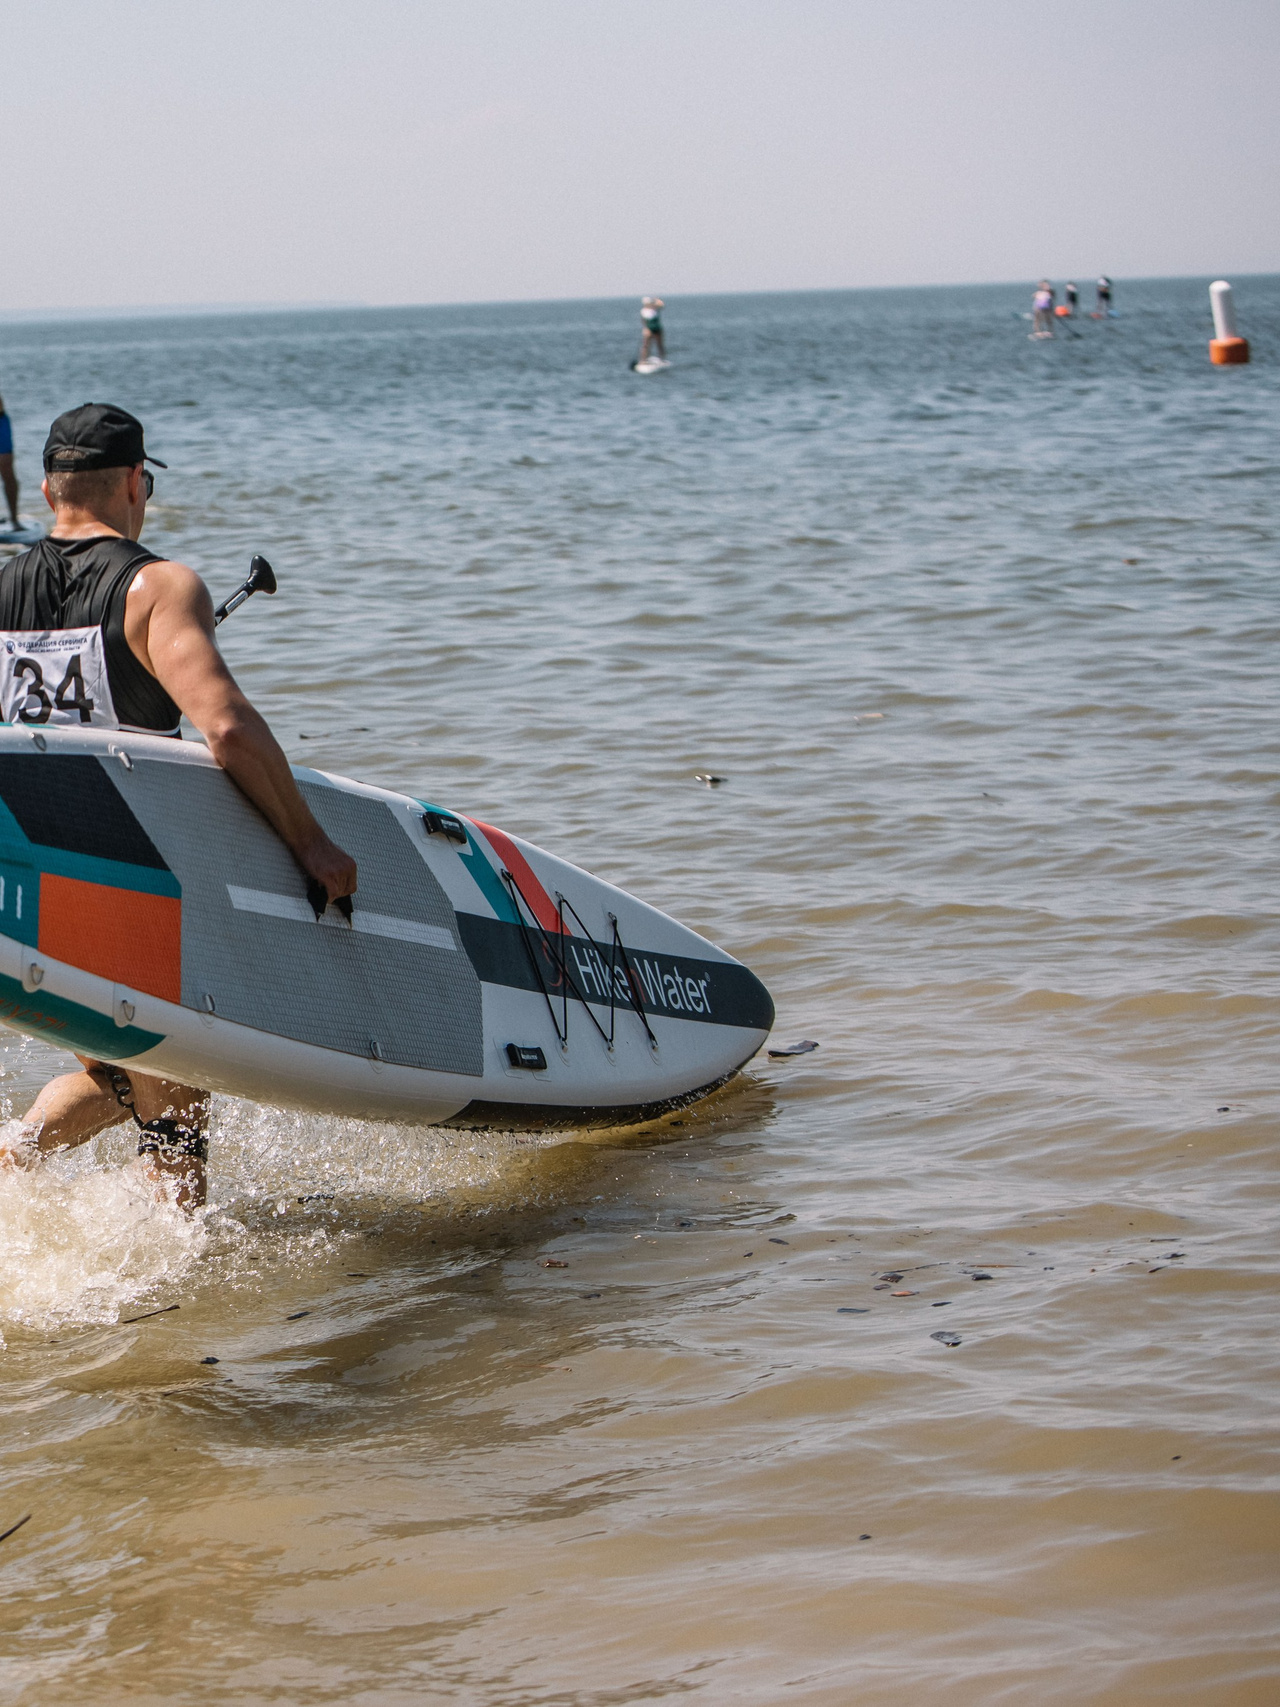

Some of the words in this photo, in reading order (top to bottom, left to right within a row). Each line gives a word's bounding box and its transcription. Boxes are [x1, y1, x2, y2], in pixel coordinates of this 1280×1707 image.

[18, 641, 57, 649] ФЕДЕРАЦИЯ
[58, 637, 88, 646] СЕРФИНГА
[14, 654, 94, 723] 34
